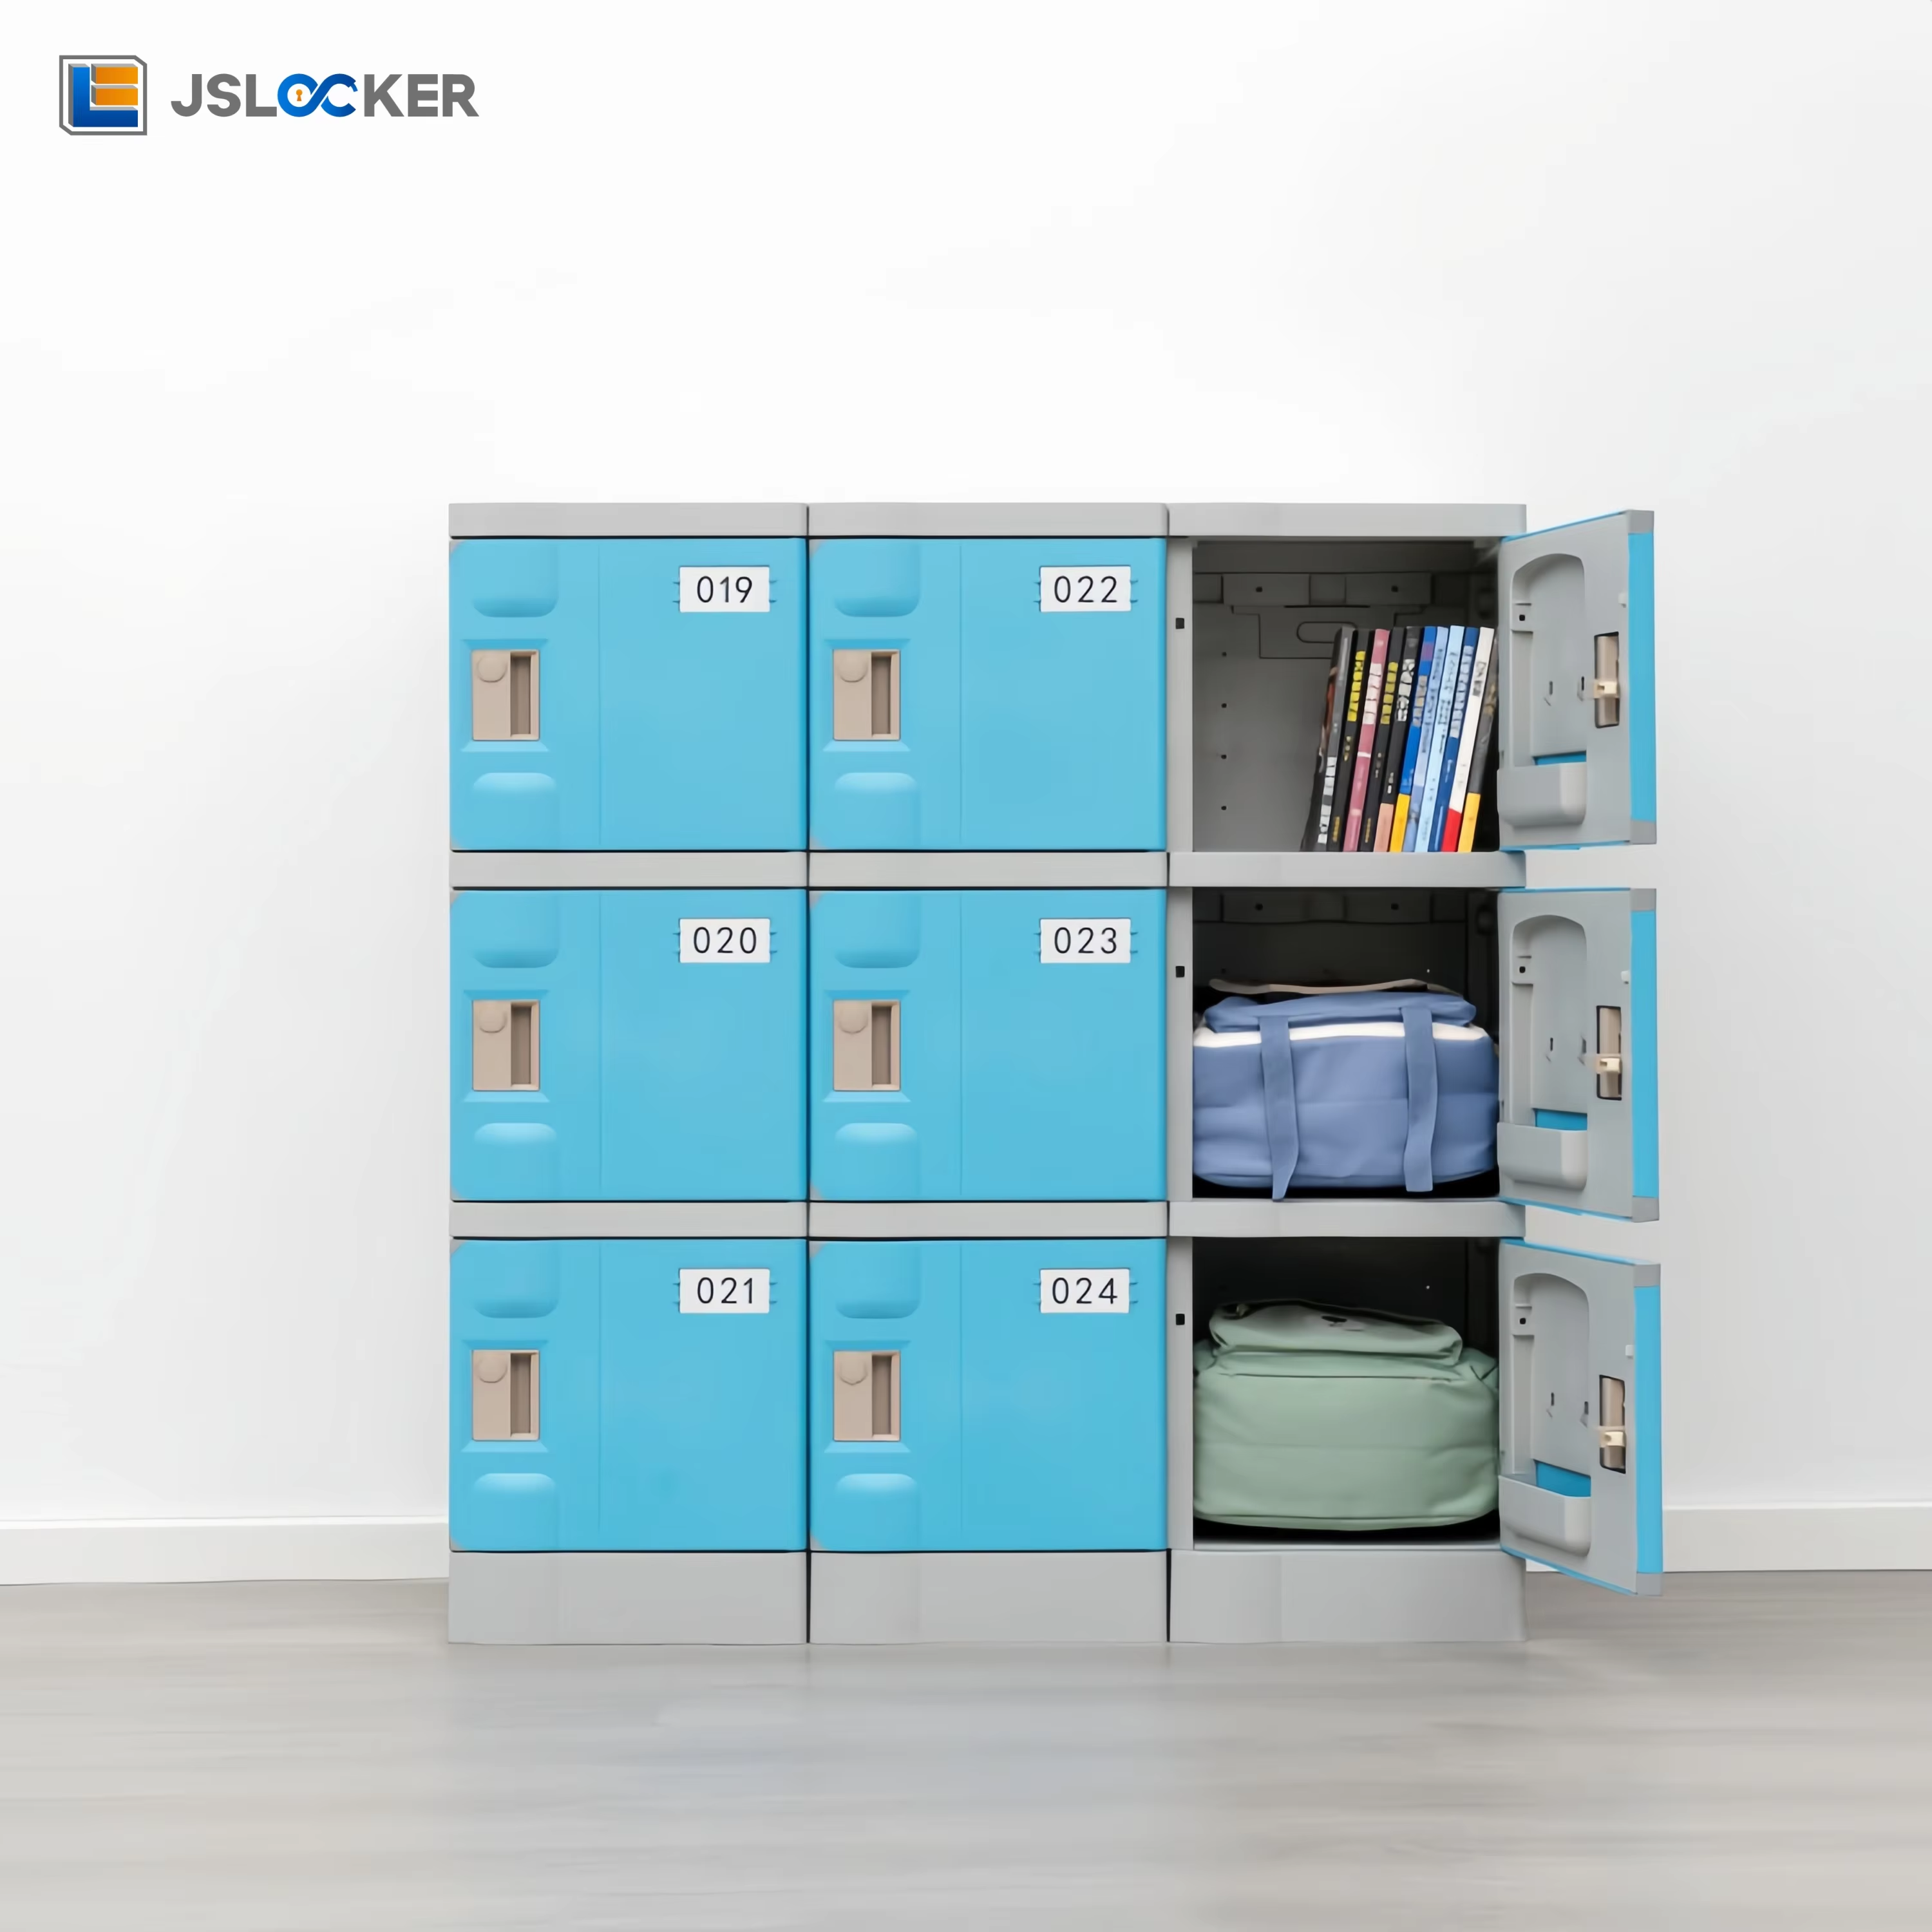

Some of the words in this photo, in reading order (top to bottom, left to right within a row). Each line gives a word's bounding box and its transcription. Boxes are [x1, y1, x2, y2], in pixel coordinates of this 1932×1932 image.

[697, 576, 753, 603] 019
[1054, 576, 1117, 603] 022
[693, 927, 757, 954] 020
[1054, 927, 1117, 954] 023
[697, 1277, 753, 1304] 021
[1052, 1277, 1118, 1305] 024
